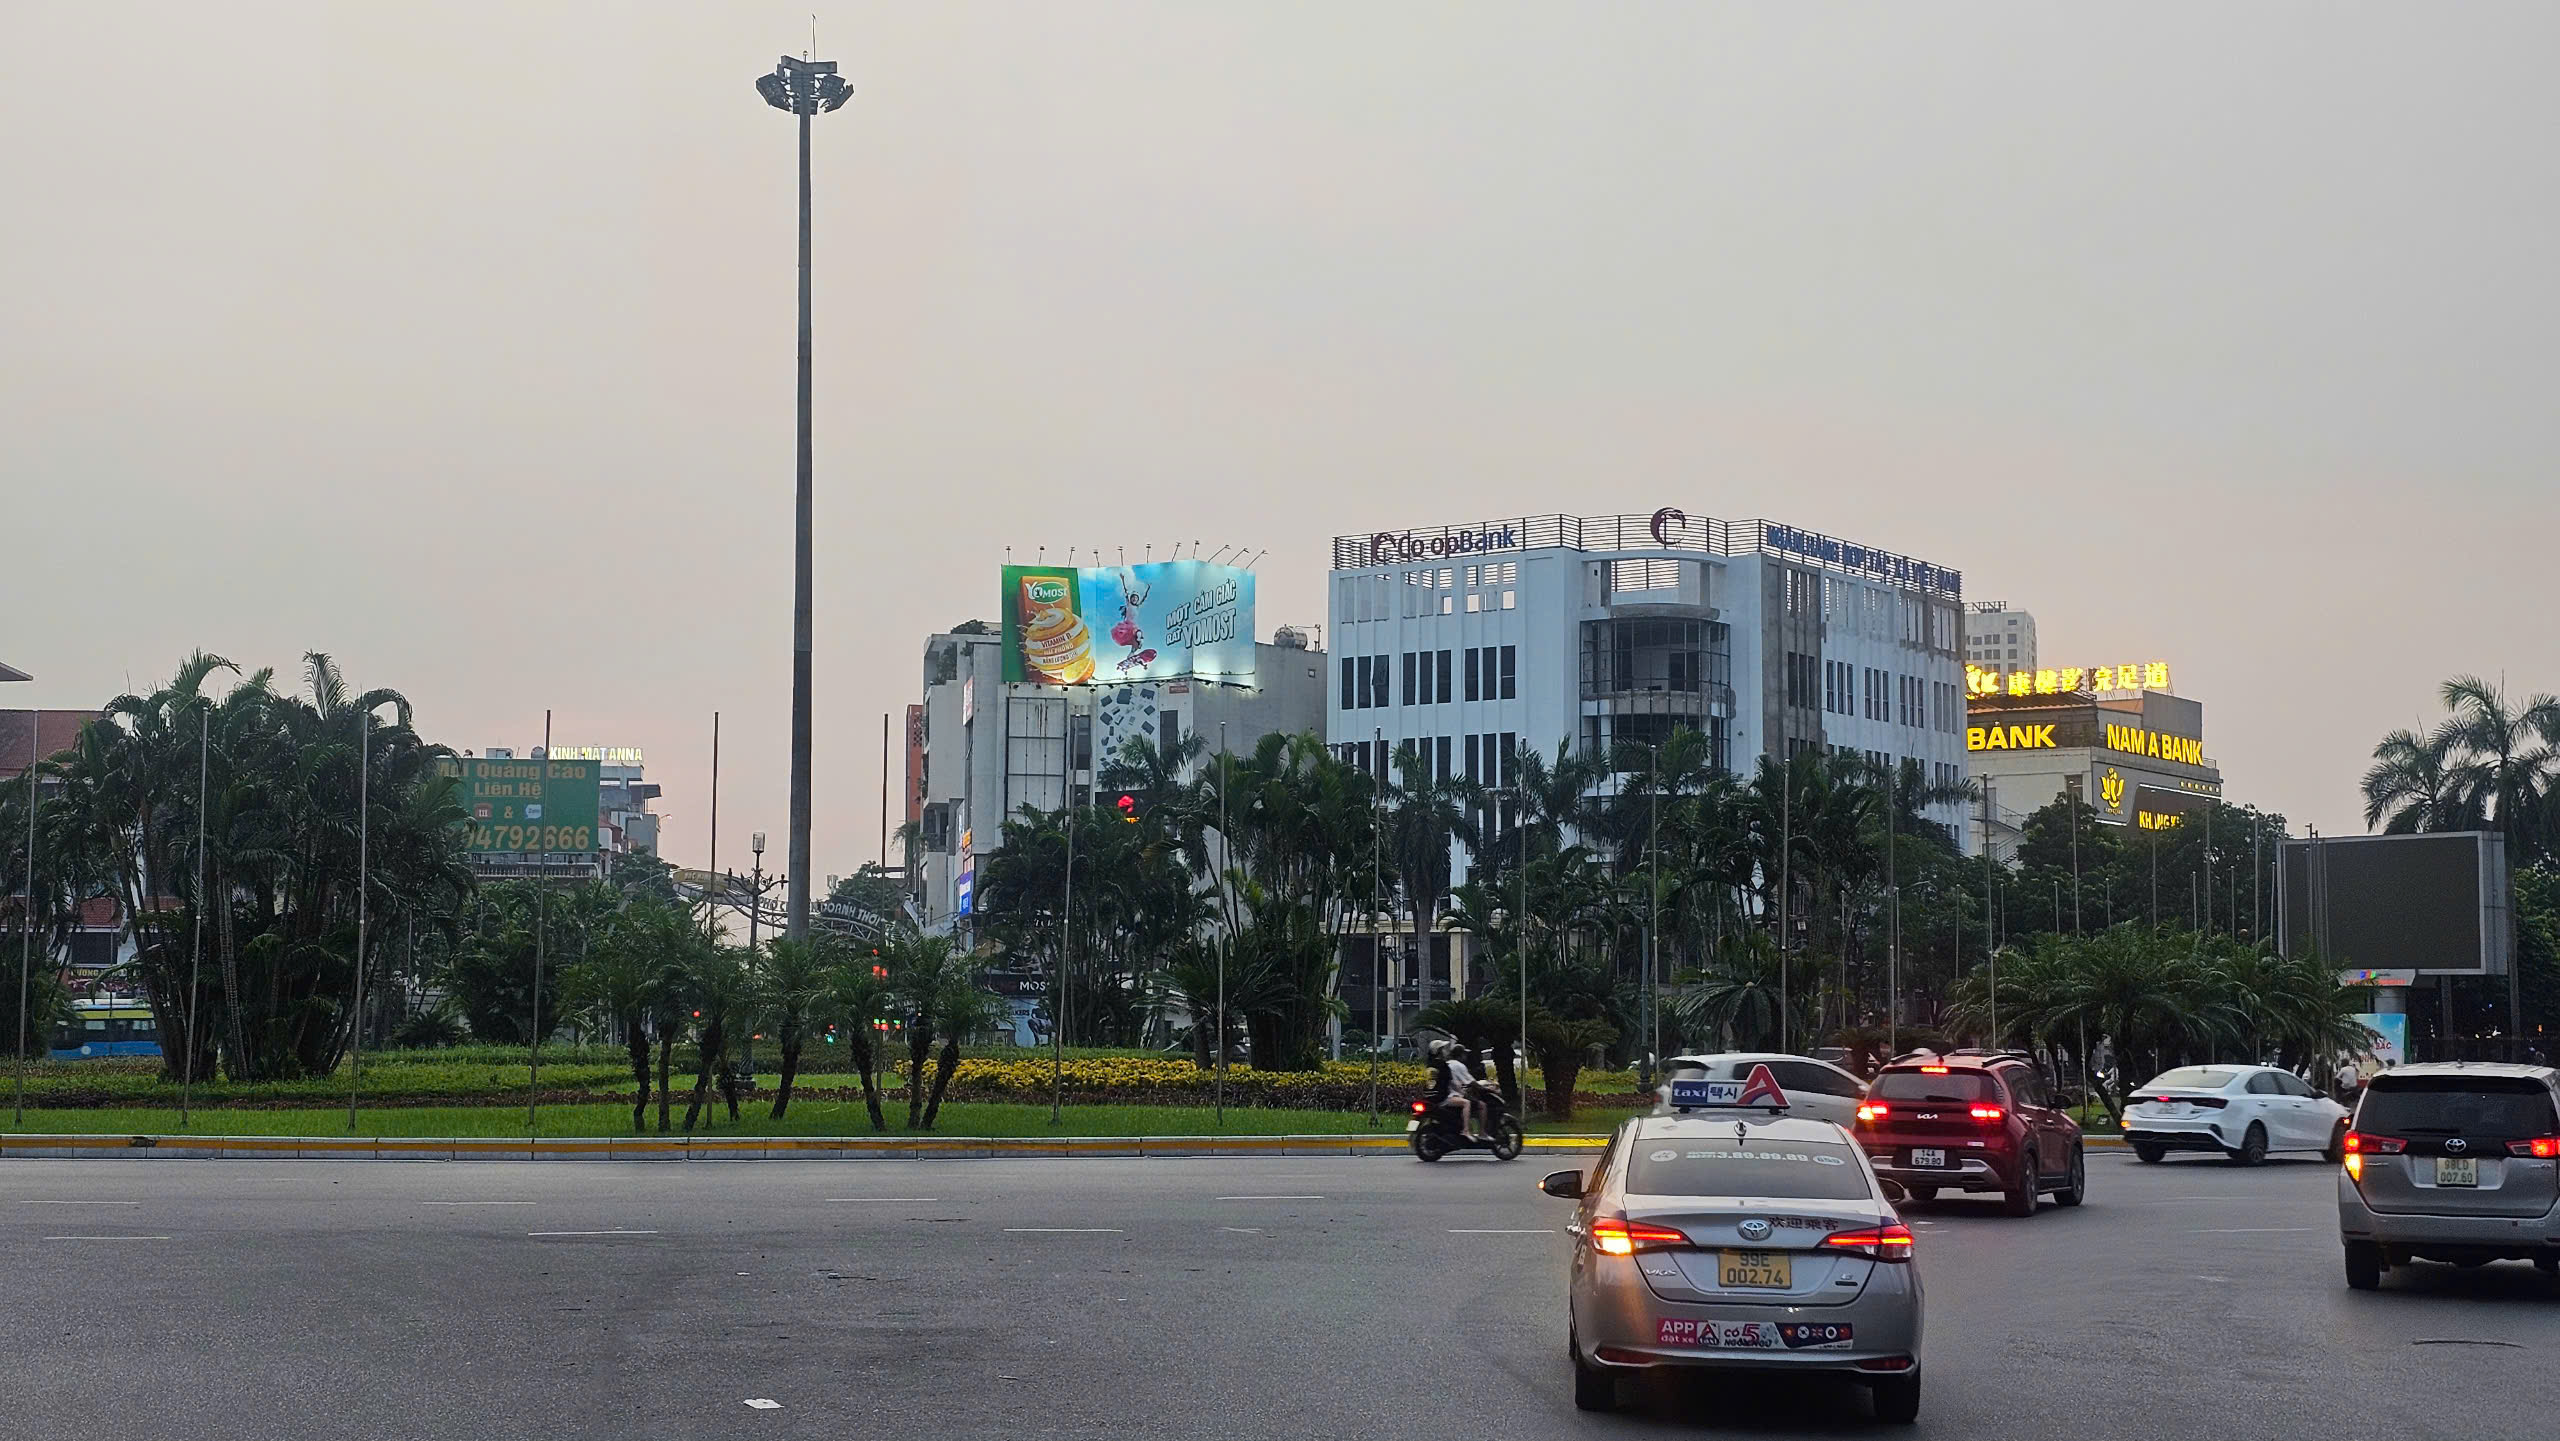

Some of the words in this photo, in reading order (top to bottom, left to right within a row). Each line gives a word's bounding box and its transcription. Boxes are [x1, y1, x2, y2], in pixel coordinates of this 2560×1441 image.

[1166, 602, 1191, 630] MỘT
[1216, 578, 1236, 606] GIÁC
[1182, 608, 1236, 649] YOMOST
[1967, 724, 2056, 750] BANK
[2107, 723, 2145, 755] NAM
[2162, 734, 2203, 766] BANK
[608, 748, 643, 761] ANNA
[477, 760, 541, 780] Quảng
[474, 782, 512, 796] Liên
[519, 782, 542, 799] Hệ
[504, 806, 514, 819] &
[1673, 1086, 1707, 1098] taxi
[1709, 1086, 1738, 1099] 택시
[1740, 1254, 1770, 1267] 99E
[1727, 1268, 1784, 1285] 002.74
[1661, 1320, 1695, 1334] APP
[1682, 1337, 1695, 1345] xe
